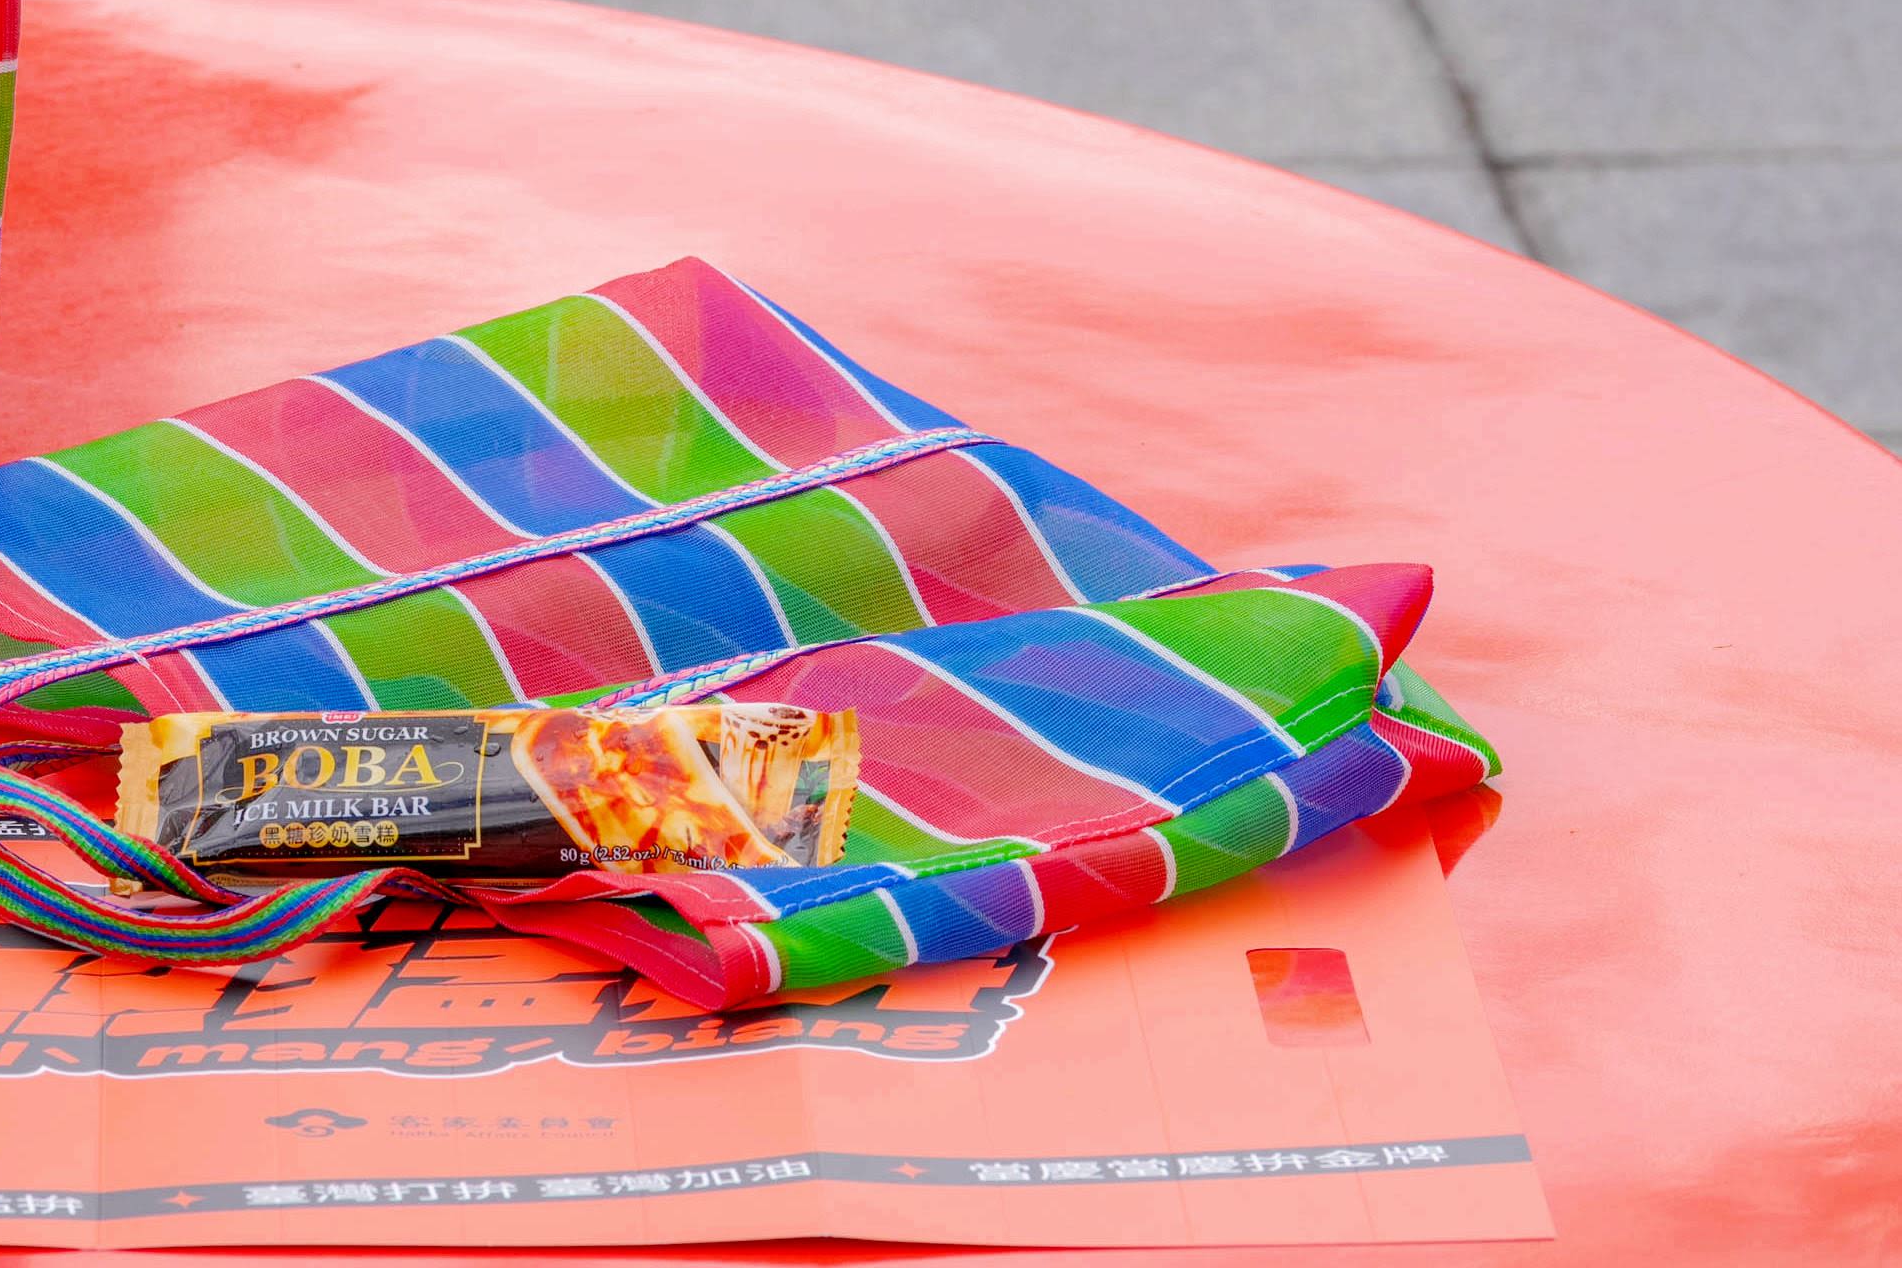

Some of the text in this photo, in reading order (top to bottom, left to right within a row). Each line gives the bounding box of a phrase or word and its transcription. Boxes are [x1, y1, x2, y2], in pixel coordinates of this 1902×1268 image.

[249, 726, 430, 750] BROWN SUGAR
[236, 744, 443, 800] BOBA
[233, 795, 433, 828] ICE MILK BAR
[261, 823, 397, 847] 黑糖珍奶雪糕
[560, 847, 578, 862] 80
[579, 851, 590, 865] g
[593, 844, 631, 862] (2.82
[633, 844, 660, 861] oz.)
[687, 856, 709, 870] ml
